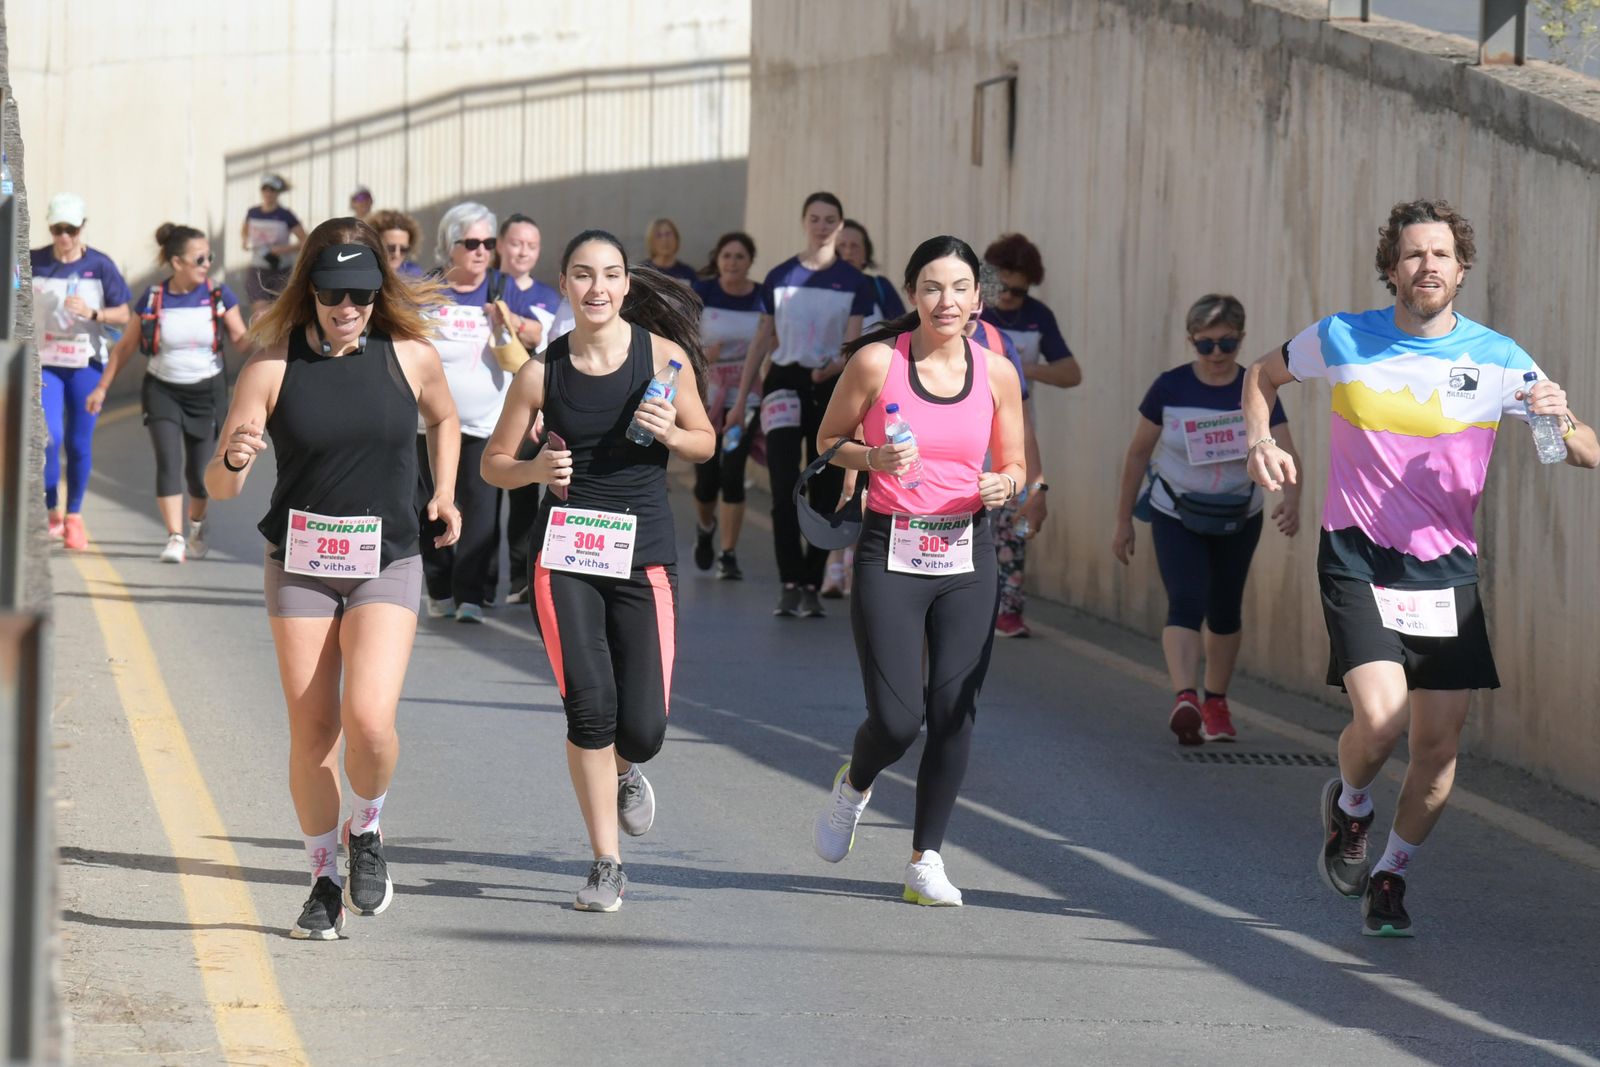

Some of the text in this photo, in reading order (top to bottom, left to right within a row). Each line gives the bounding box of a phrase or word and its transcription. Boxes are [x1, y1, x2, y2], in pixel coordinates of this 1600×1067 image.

[316, 537, 350, 555] 289
[574, 531, 605, 551] 304
[918, 535, 949, 553] 305
[323, 562, 357, 571] vithas
[578, 559, 610, 569] vithas
[924, 560, 954, 569] vithas
